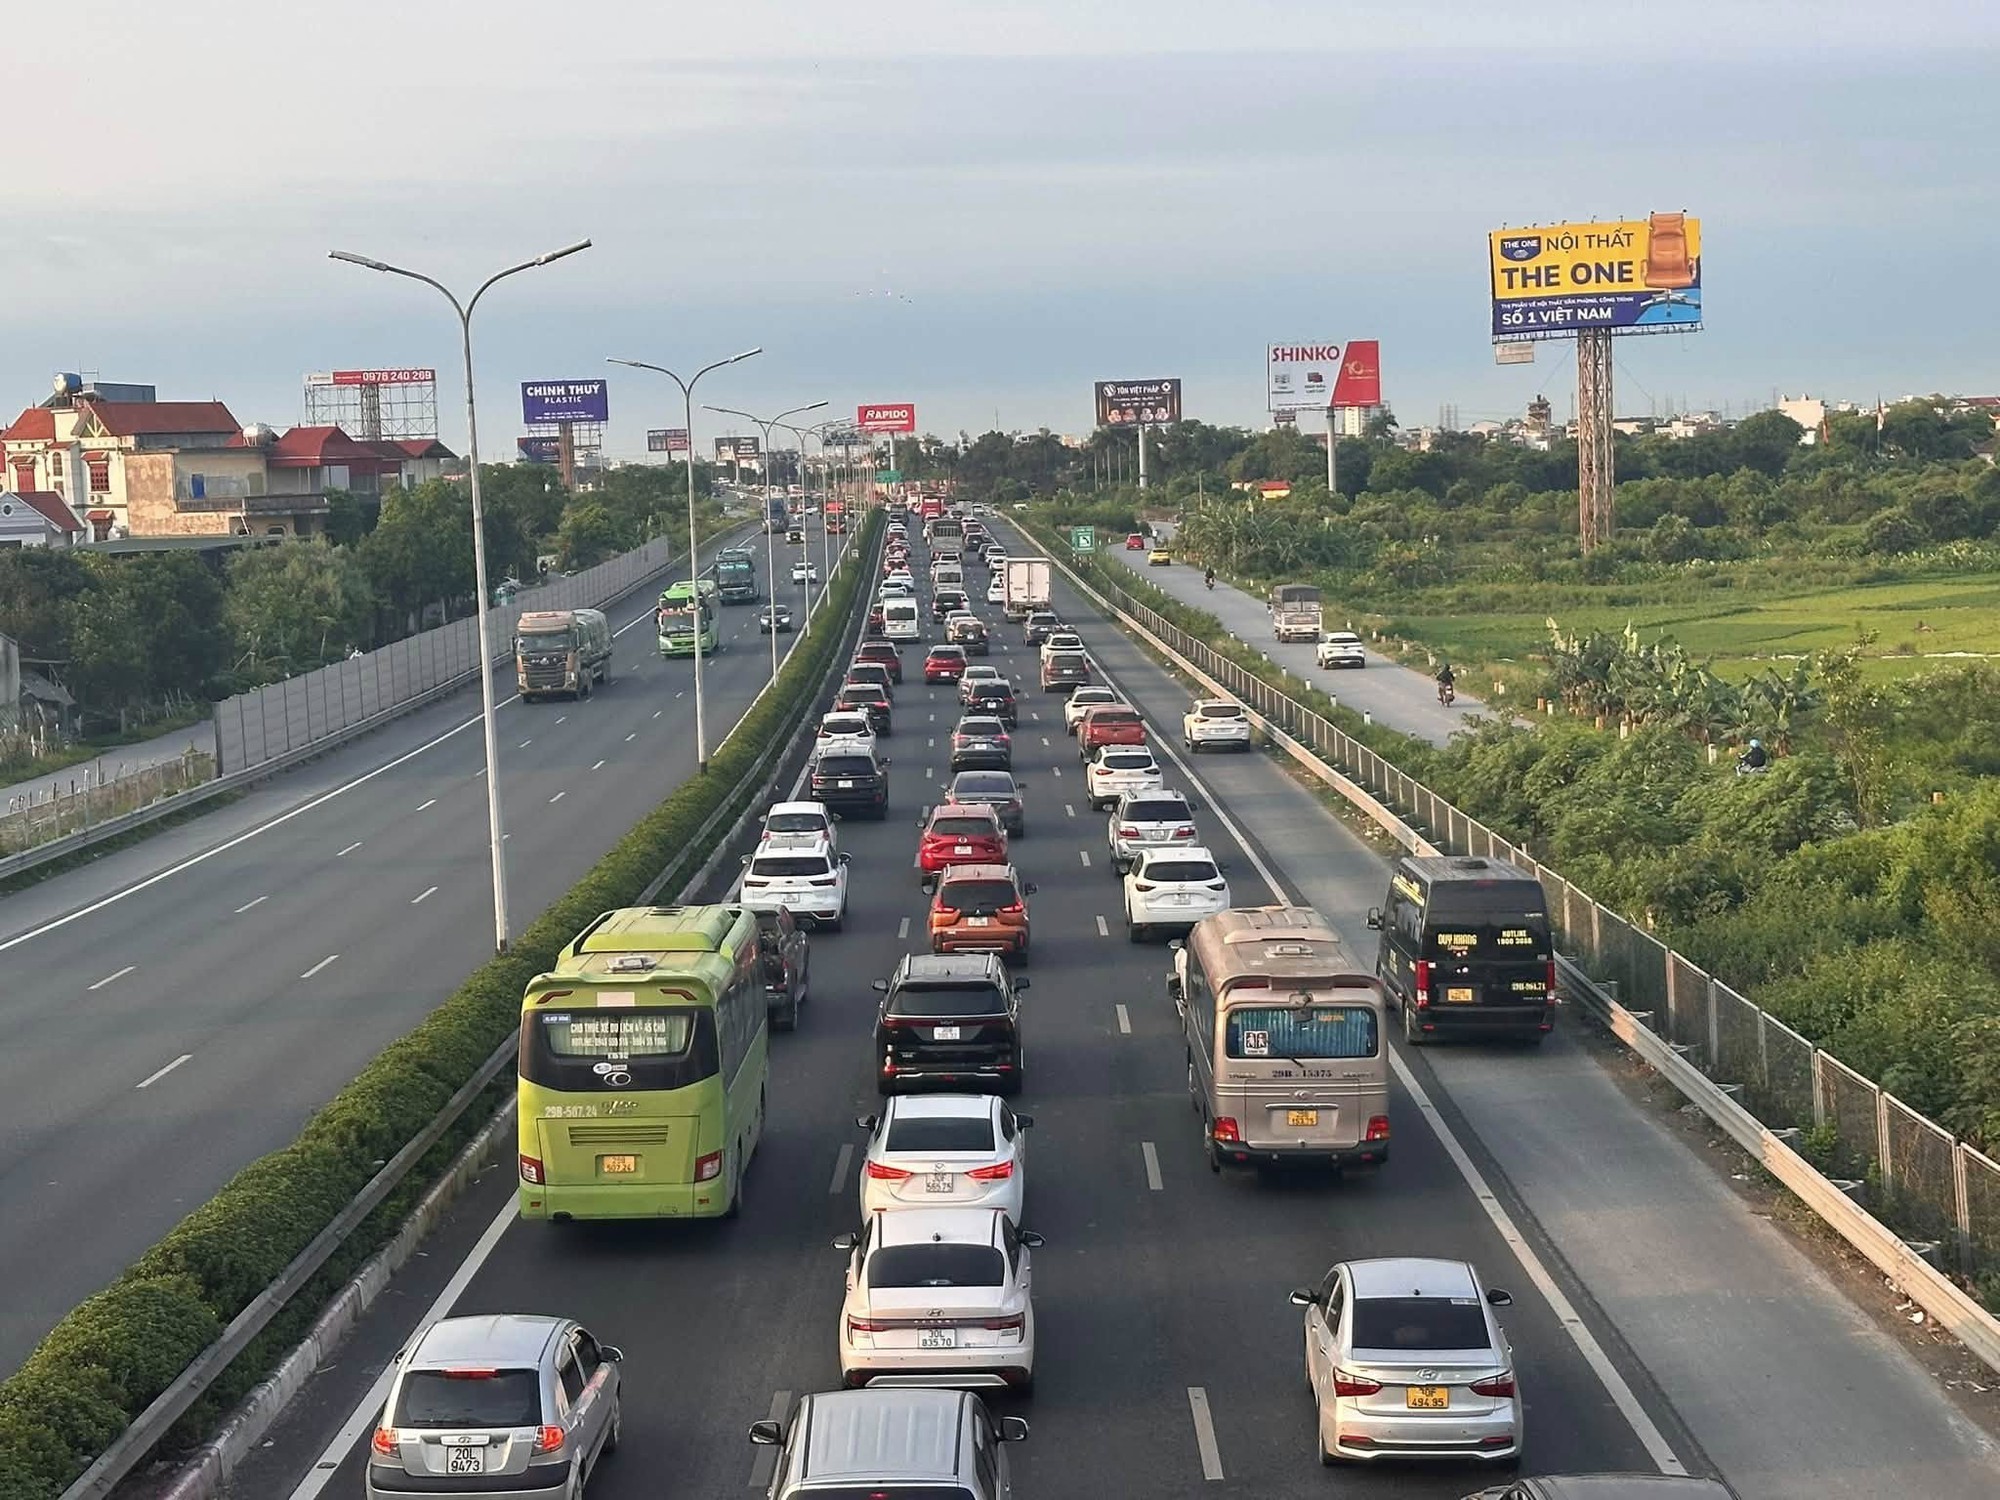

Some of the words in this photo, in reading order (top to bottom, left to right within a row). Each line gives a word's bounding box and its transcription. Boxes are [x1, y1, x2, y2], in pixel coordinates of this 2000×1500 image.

[1503, 241, 1520, 249] THE
[1521, 240, 1539, 248] ONE
[1546, 232, 1579, 253] NỘI
[1584, 228, 1634, 248] THẤT
[1501, 265, 1560, 289] THE
[1570, 261, 1633, 284] ONE
[1502, 308, 1523, 325] SỐ
[1528, 312, 1536, 323] 1
[1540, 307, 1573, 324] VIỆT
[1577, 307, 1612, 320] NAM
[1272, 346, 1340, 361] SHINKO
[363, 372, 388, 381] 0976
[391, 372, 410, 380] 240
[527, 385, 565, 396] CHINH
[545, 396, 582, 404] PLASTIC
[865, 410, 908, 419] RAPIDO
[928, 1329, 945, 1337] 30L
[455, 1448, 476, 1460] 20L
[451, 1460, 480, 1472] 9473
